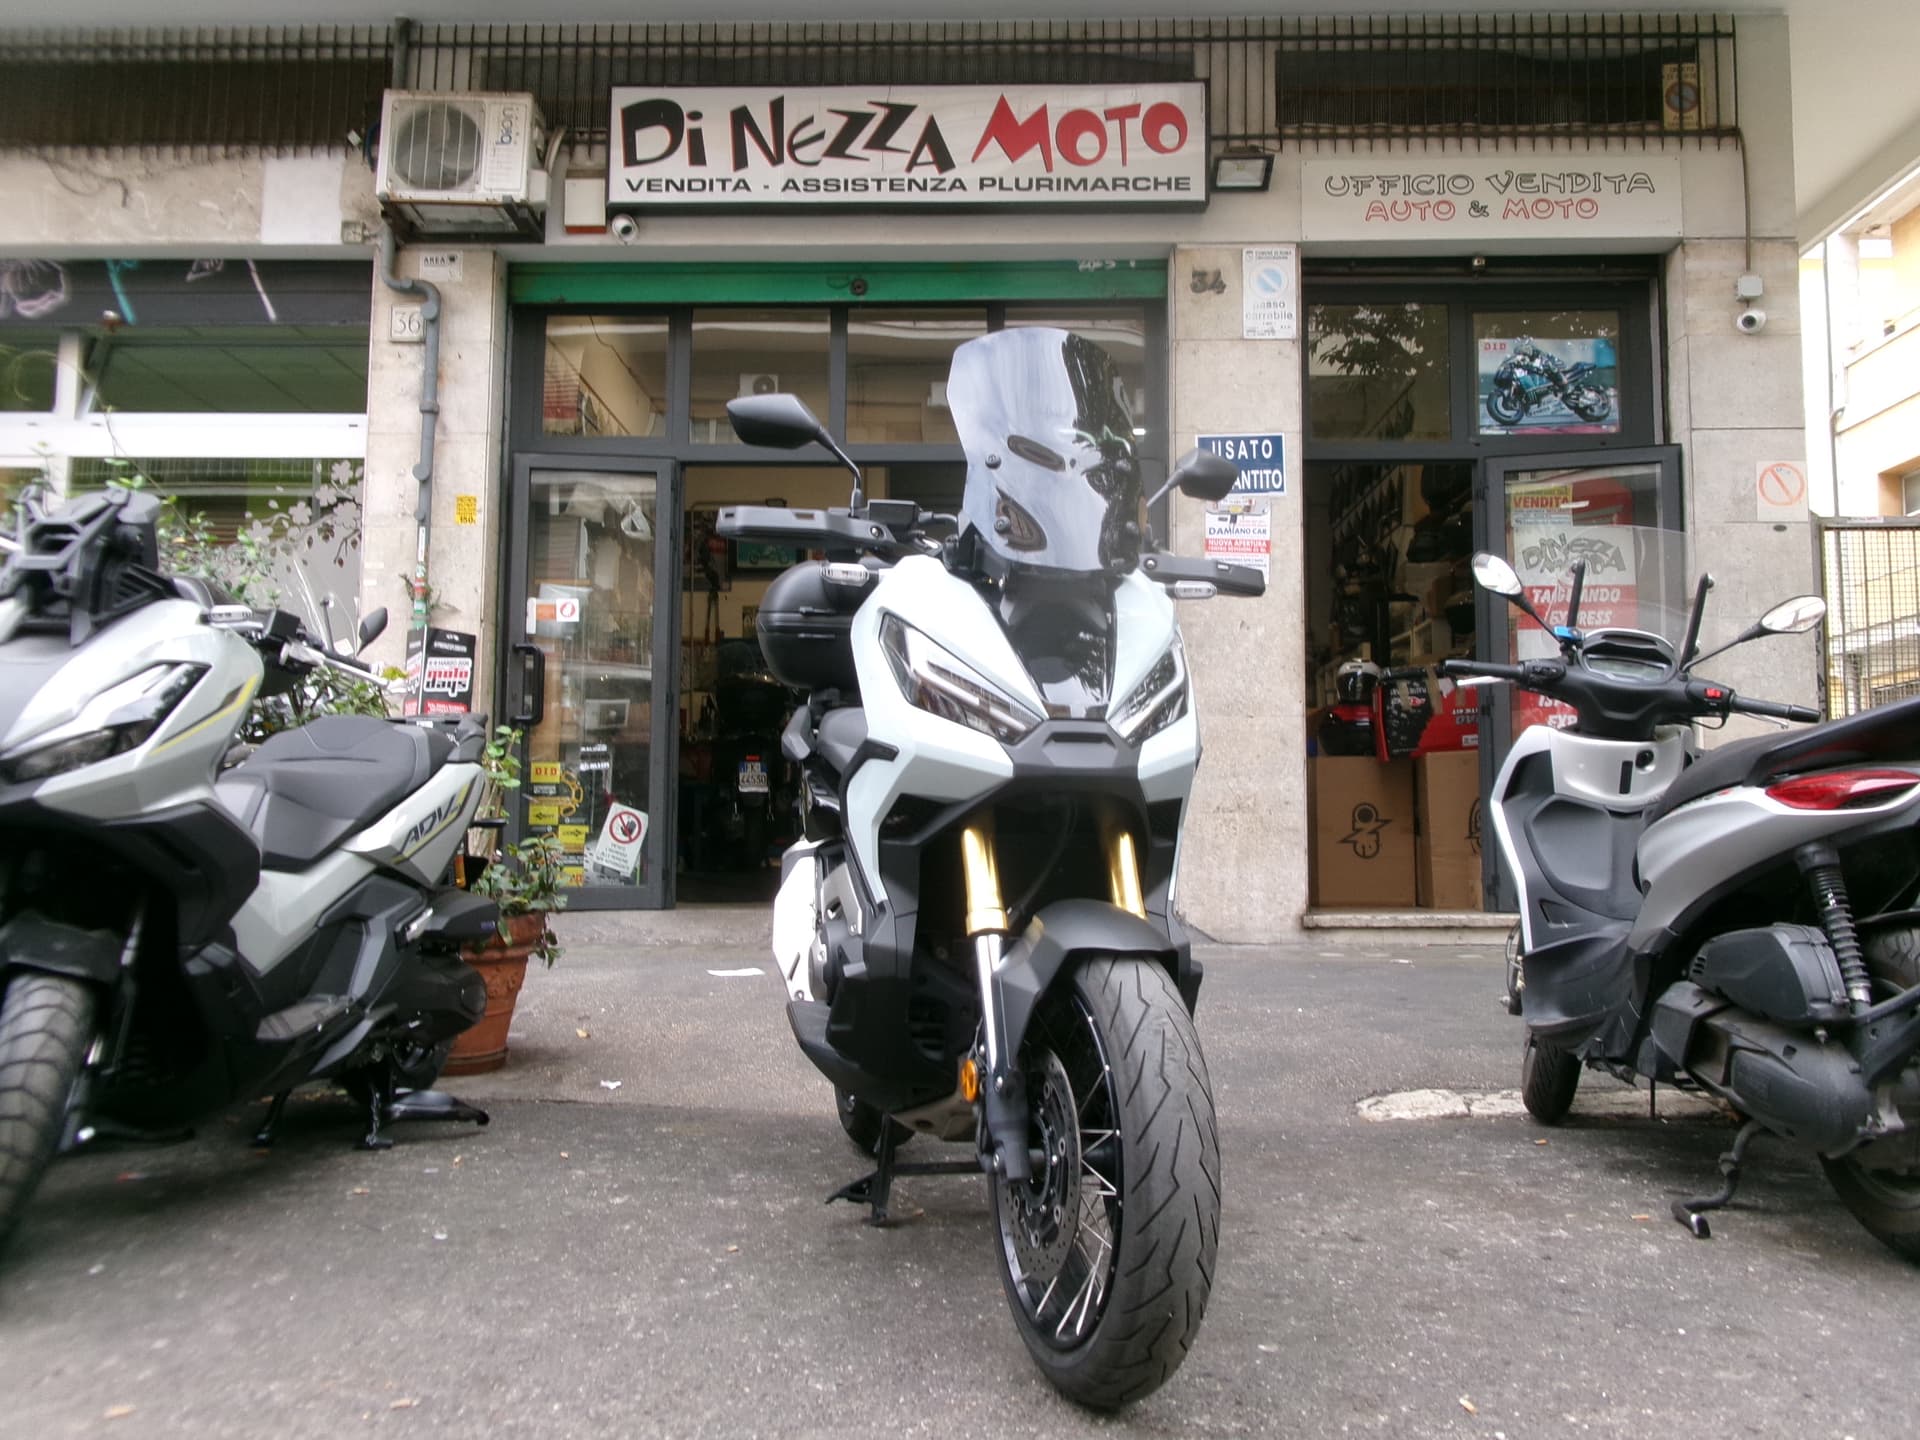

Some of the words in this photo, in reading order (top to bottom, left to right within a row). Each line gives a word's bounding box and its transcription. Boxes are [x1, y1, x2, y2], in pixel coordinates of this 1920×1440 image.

[970, 93, 1188, 173] MOTO
[625, 177, 752, 193] VENDITA
[782, 177, 967, 193] ASSISTENZA
[978, 175, 1191, 193] PLURIMARCHE
[1325, 173, 1475, 197] UFFICIO
[1485, 170, 1655, 196] VENDITA
[1365, 199, 1456, 222] AUTO
[1468, 200, 1490, 218] &
[1502, 197, 1599, 221] MOTO
[423, 256, 447, 265] AREA
[394, 310, 421, 336] 36
[1208, 527, 1251, 536] DAMIANO
[1252, 527, 1267, 535] CAR
[1549, 609, 1613, 626] EXRESS
[425, 679, 468, 694] days
